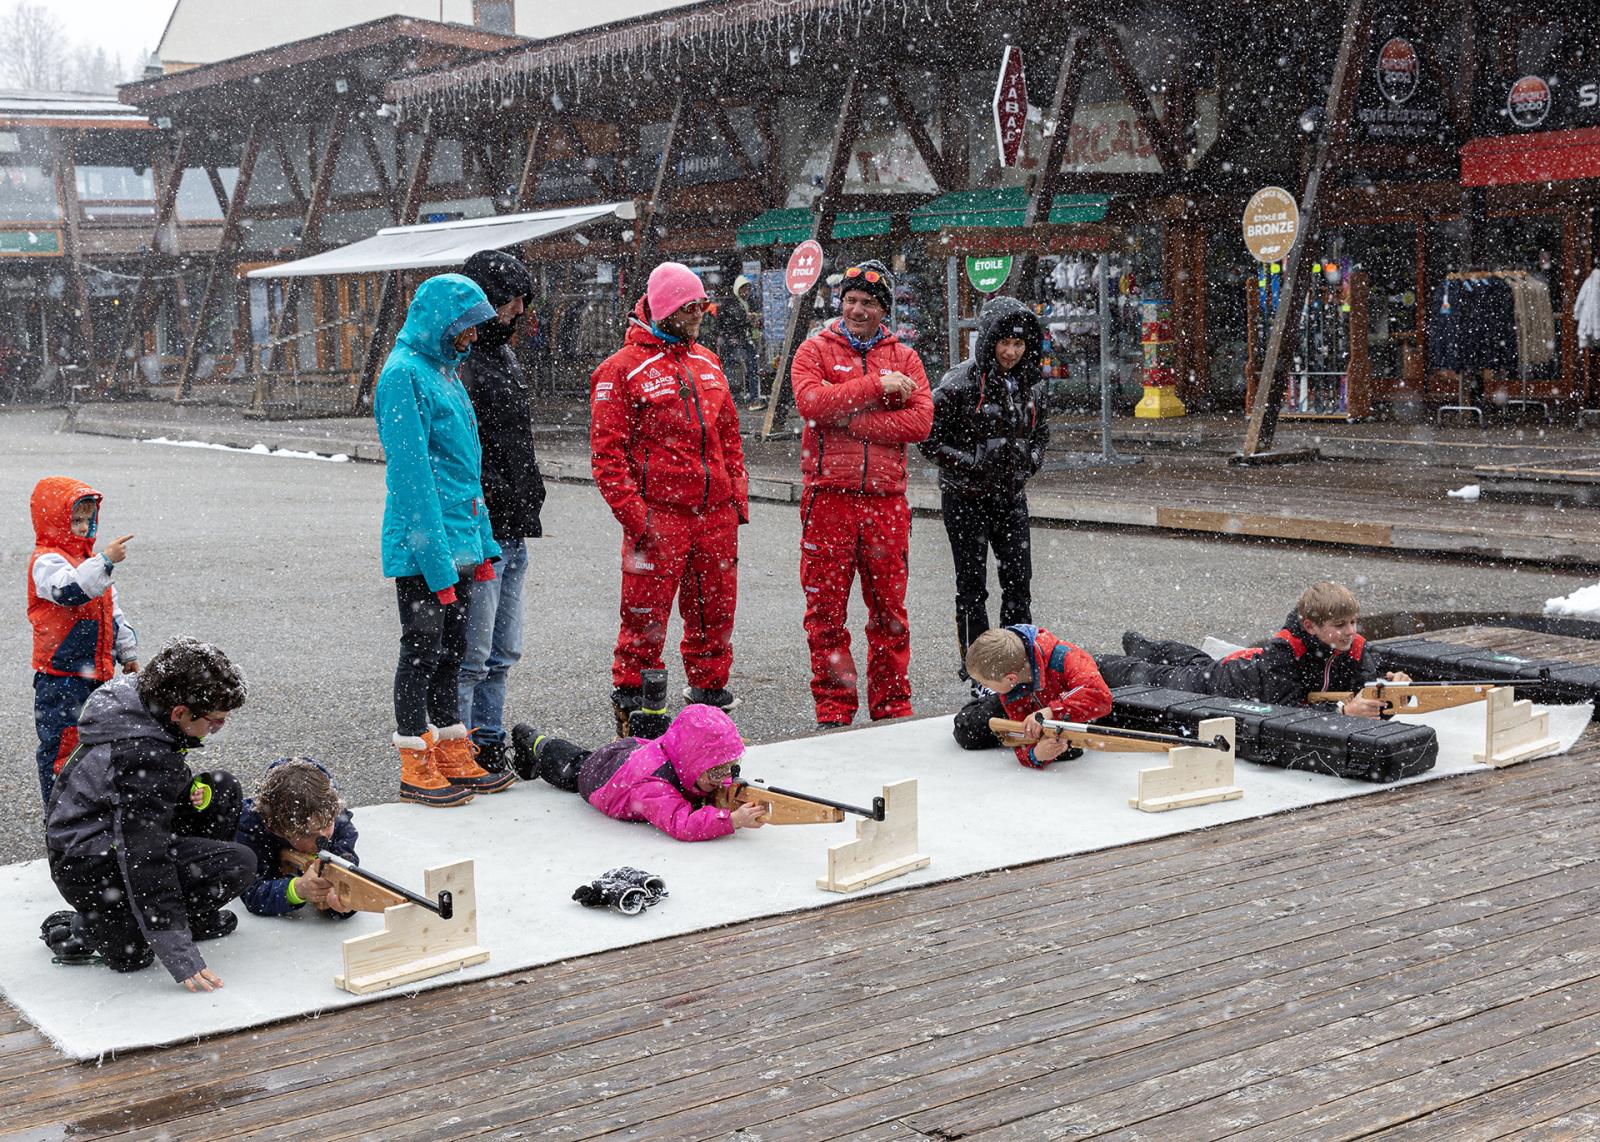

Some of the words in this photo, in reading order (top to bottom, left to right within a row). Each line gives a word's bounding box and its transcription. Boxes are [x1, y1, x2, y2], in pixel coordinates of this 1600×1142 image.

[1005, 74, 1019, 141] TABAC
[1247, 221, 1295, 237] BRONZE
[974, 259, 1004, 271] ÉTOILE
